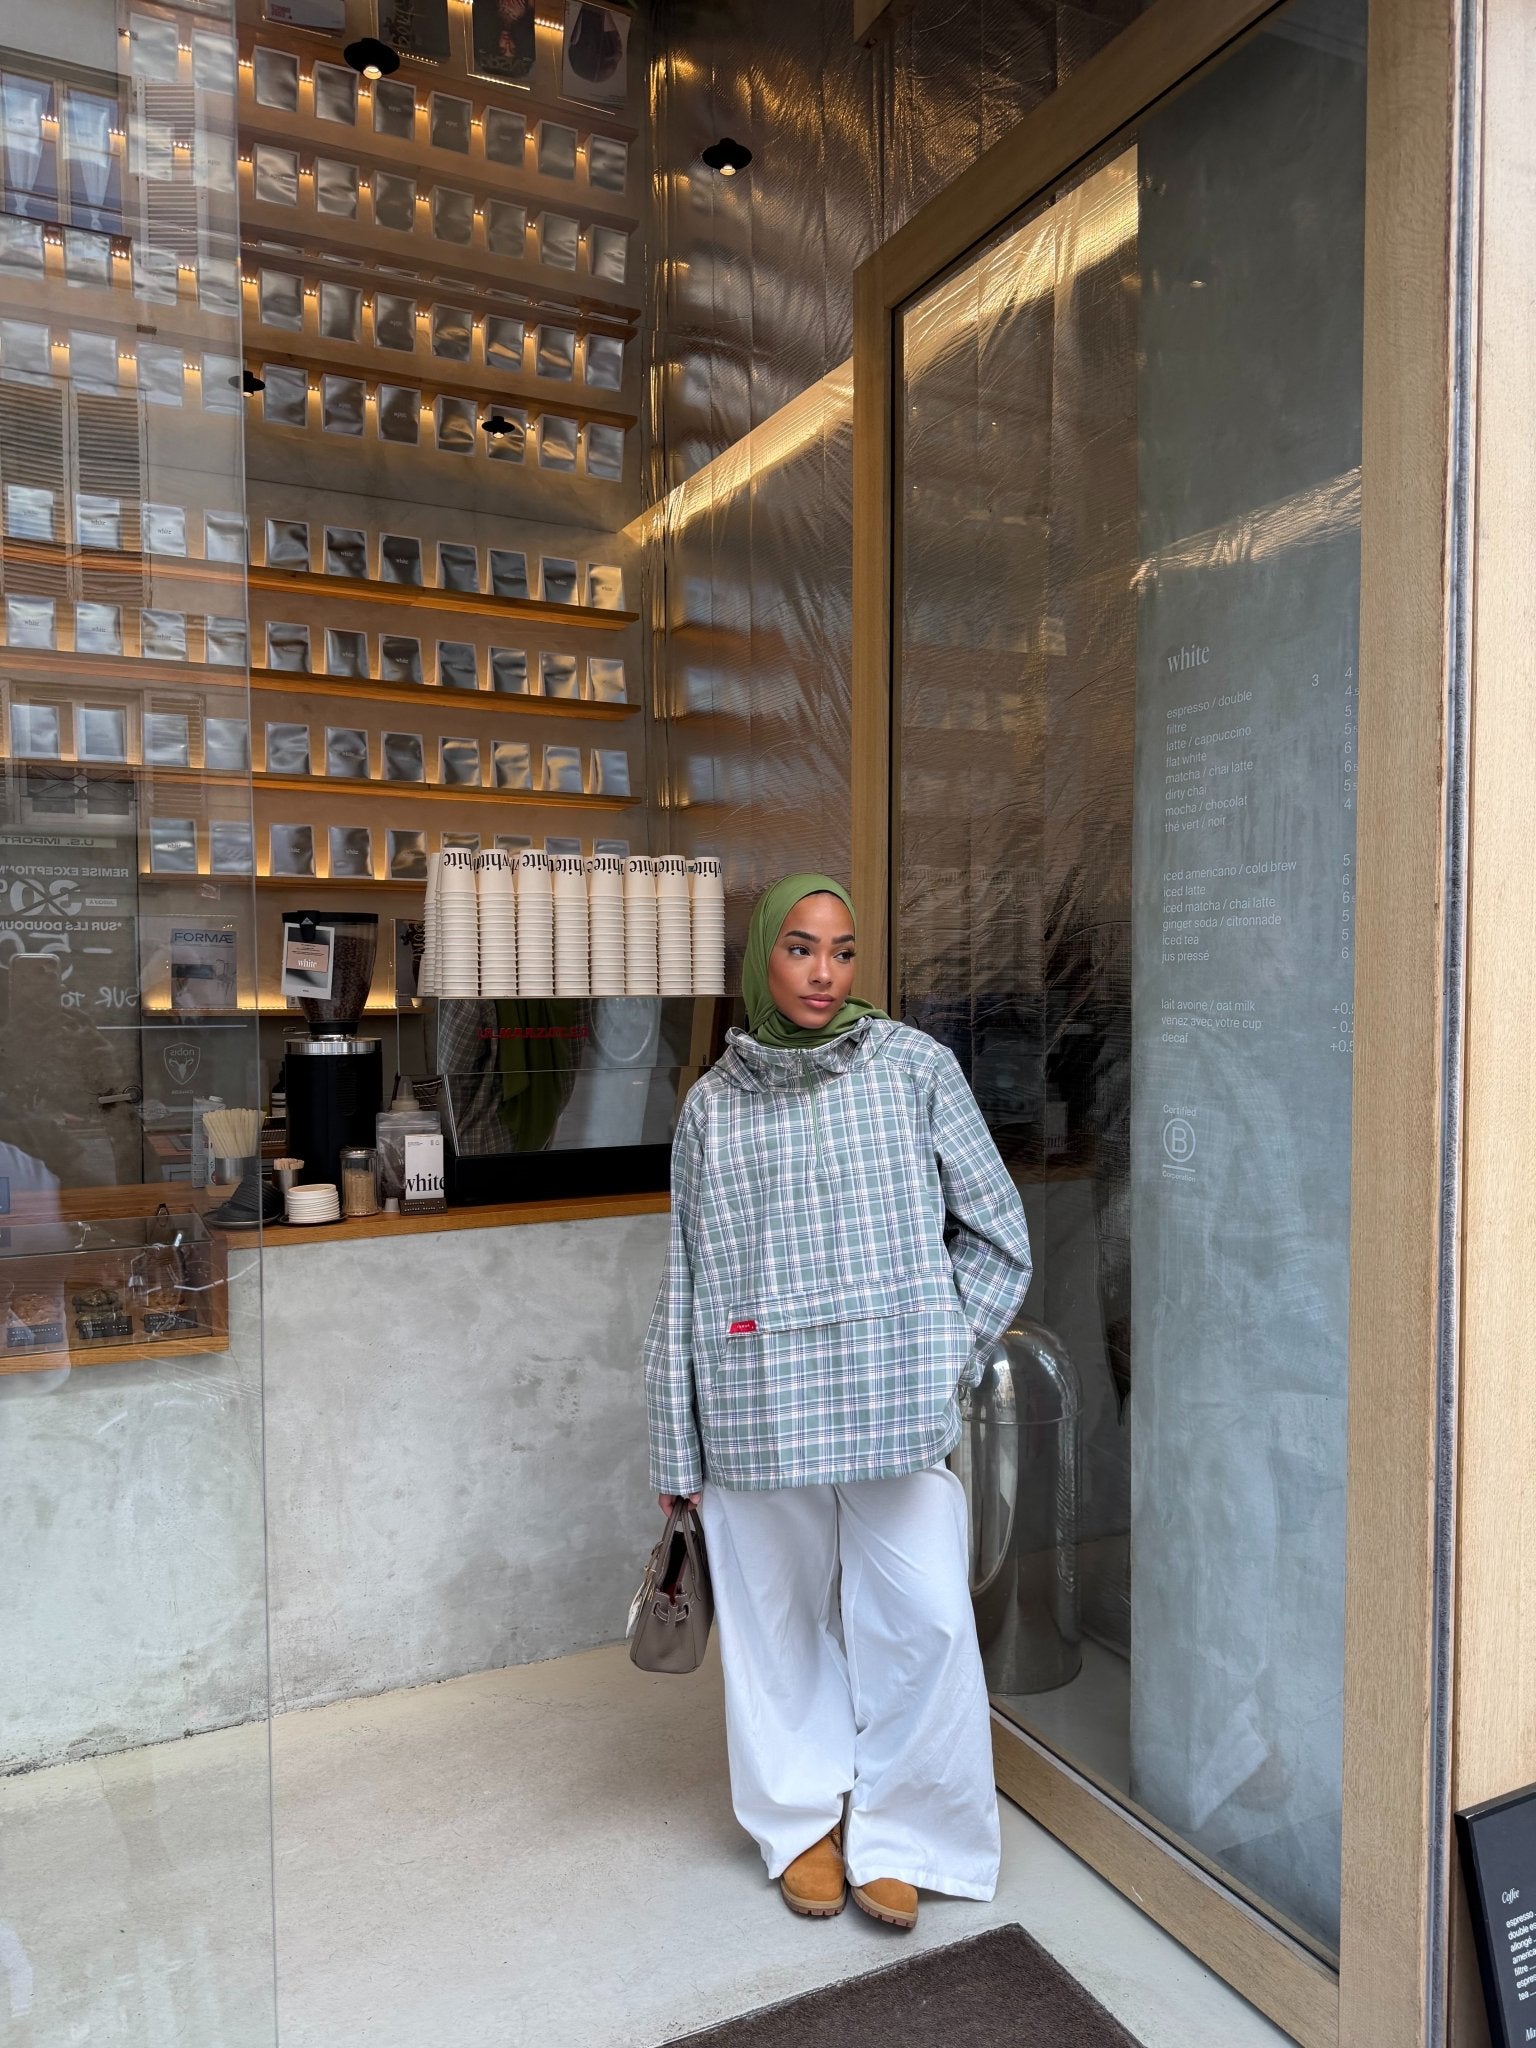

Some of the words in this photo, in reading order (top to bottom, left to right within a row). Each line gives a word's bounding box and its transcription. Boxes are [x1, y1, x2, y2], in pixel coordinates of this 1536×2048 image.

[1167, 644, 1210, 673] white
[1166, 701, 1210, 719] espresso
[1218, 690, 1252, 707] double
[1311, 674, 1320, 687] 3
[1344, 666, 1352, 678] 4
[1166, 740, 1187, 752] latte
[1194, 726, 1252, 746] cappuccino
[1344, 704, 1352, 717] 5
[1166, 722, 1187, 735] filtre
[1165, 770, 1200, 784] matcha
[1208, 764, 1229, 777] chai
[1231, 760, 1253, 773] latte
[1344, 741, 1352, 754] 6
[1166, 756, 1180, 768] flat
[1182, 751, 1207, 765] white
[1165, 787, 1185, 802] dirty
[1187, 785, 1207, 798] chai
[1165, 803, 1197, 817] mocha
[1205, 795, 1248, 812] chocolat
[1207, 813, 1227, 828] noir
[1343, 797, 1352, 810] 4
[1163, 869, 1184, 881] iced
[1185, 867, 1237, 880] americano
[1245, 861, 1268, 875] cold
[1270, 860, 1297, 873] brew
[1342, 854, 1351, 867] 5
[1163, 886, 1183, 898] iced
[1185, 884, 1206, 897] latte
[1342, 873, 1351, 886] 6
[1163, 902, 1183, 914] iced
[1185, 900, 1221, 913] matcha
[1229, 896, 1251, 910] chai
[1252, 895, 1277, 909] latte
[1162, 918, 1192, 931] ginger
[1194, 915, 1218, 928] soda
[1226, 911, 1282, 928] citronnade
[1342, 910, 1350, 923] 5
[1162, 934, 1182, 946] iced
[1183, 934, 1199, 945] tea
[1341, 928, 1349, 941] 5
[298, 959, 318, 968] white
[1161, 951, 1176, 964] jus
[1177, 949, 1210, 964] pressé
[1341, 946, 1349, 959] 6
[1161, 998, 1175, 1010] lait
[1177, 1000, 1208, 1012] avoine
[1216, 1000, 1233, 1012] oat
[1234, 1000, 1256, 1012] milk
[1332, 1001, 1354, 1015] +0.
[1161, 1016, 1188, 1027] venez
[1190, 1017, 1213, 1028] avec
[1215, 1018, 1240, 1029] votre
[1242, 1019, 1262, 1031] cup
[1162, 1032, 1189, 1044] decaf
[1163, 1104, 1197, 1117] Certified
[1172, 1126, 1188, 1153] B
[1502, 1887, 1519, 1904] Coffee
[1506, 1911, 1534, 1928] espresso
[1508, 1925, 1529, 1941] double
[1518, 1990, 1530, 2001] tea
